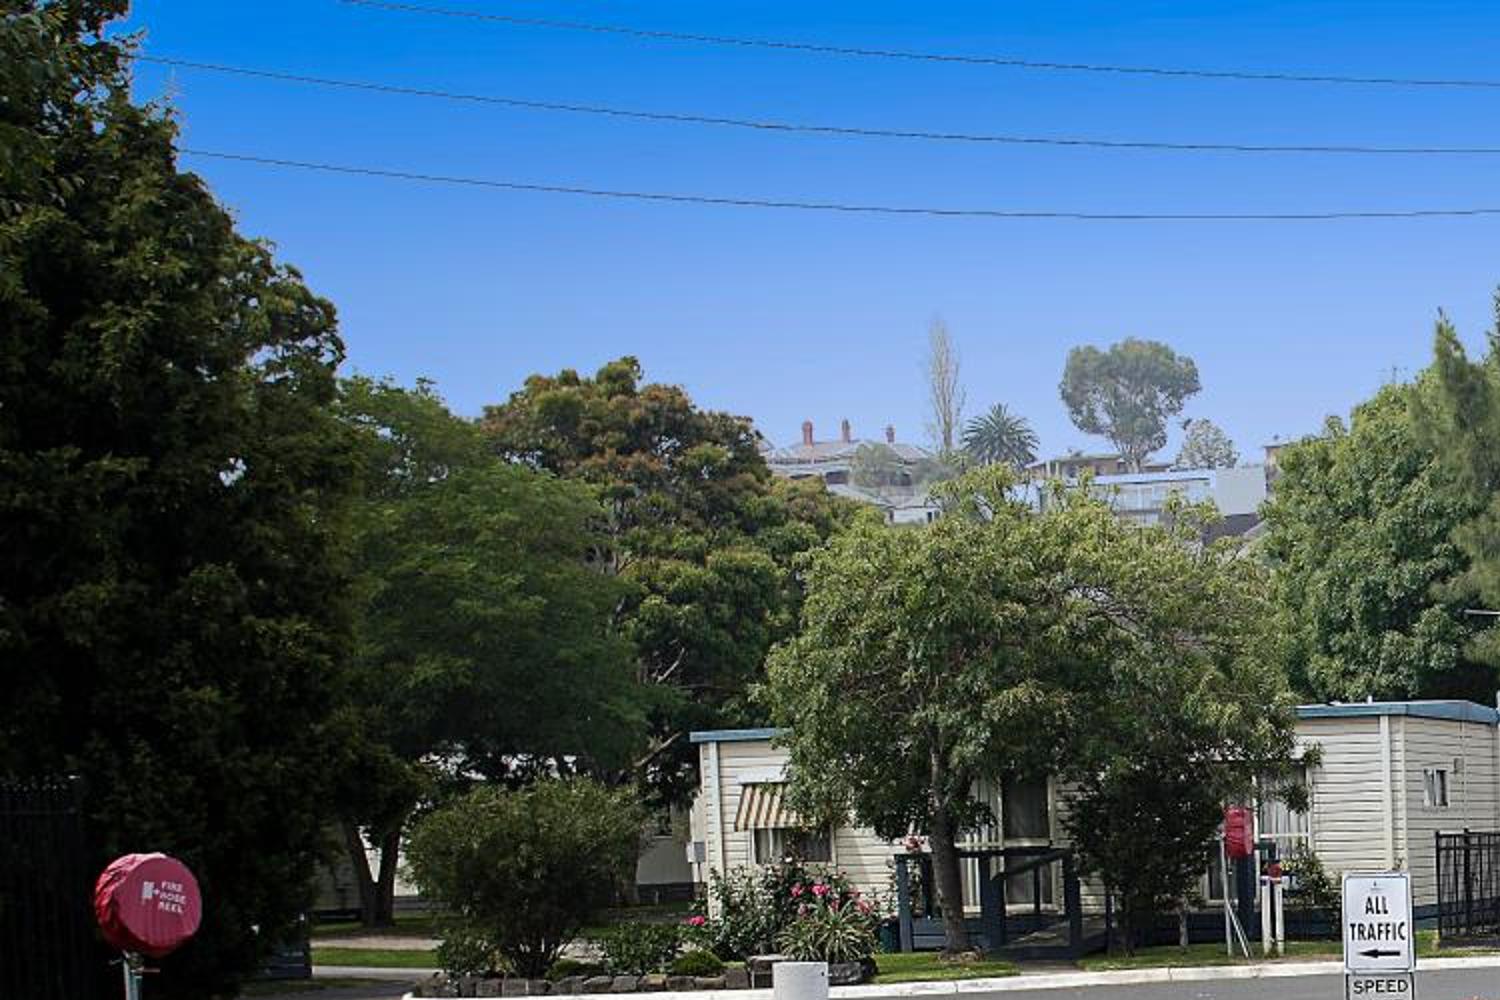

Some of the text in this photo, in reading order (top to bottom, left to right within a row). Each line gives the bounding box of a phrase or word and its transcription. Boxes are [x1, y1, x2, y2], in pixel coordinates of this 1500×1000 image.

[161, 881, 183, 892] FIRE
[160, 892, 186, 904] HOSE
[158, 901, 184, 914] REEL
[1365, 896, 1389, 915] ALL
[1350, 922, 1406, 941] TRAFFIC
[1353, 979, 1409, 995] SPEED
